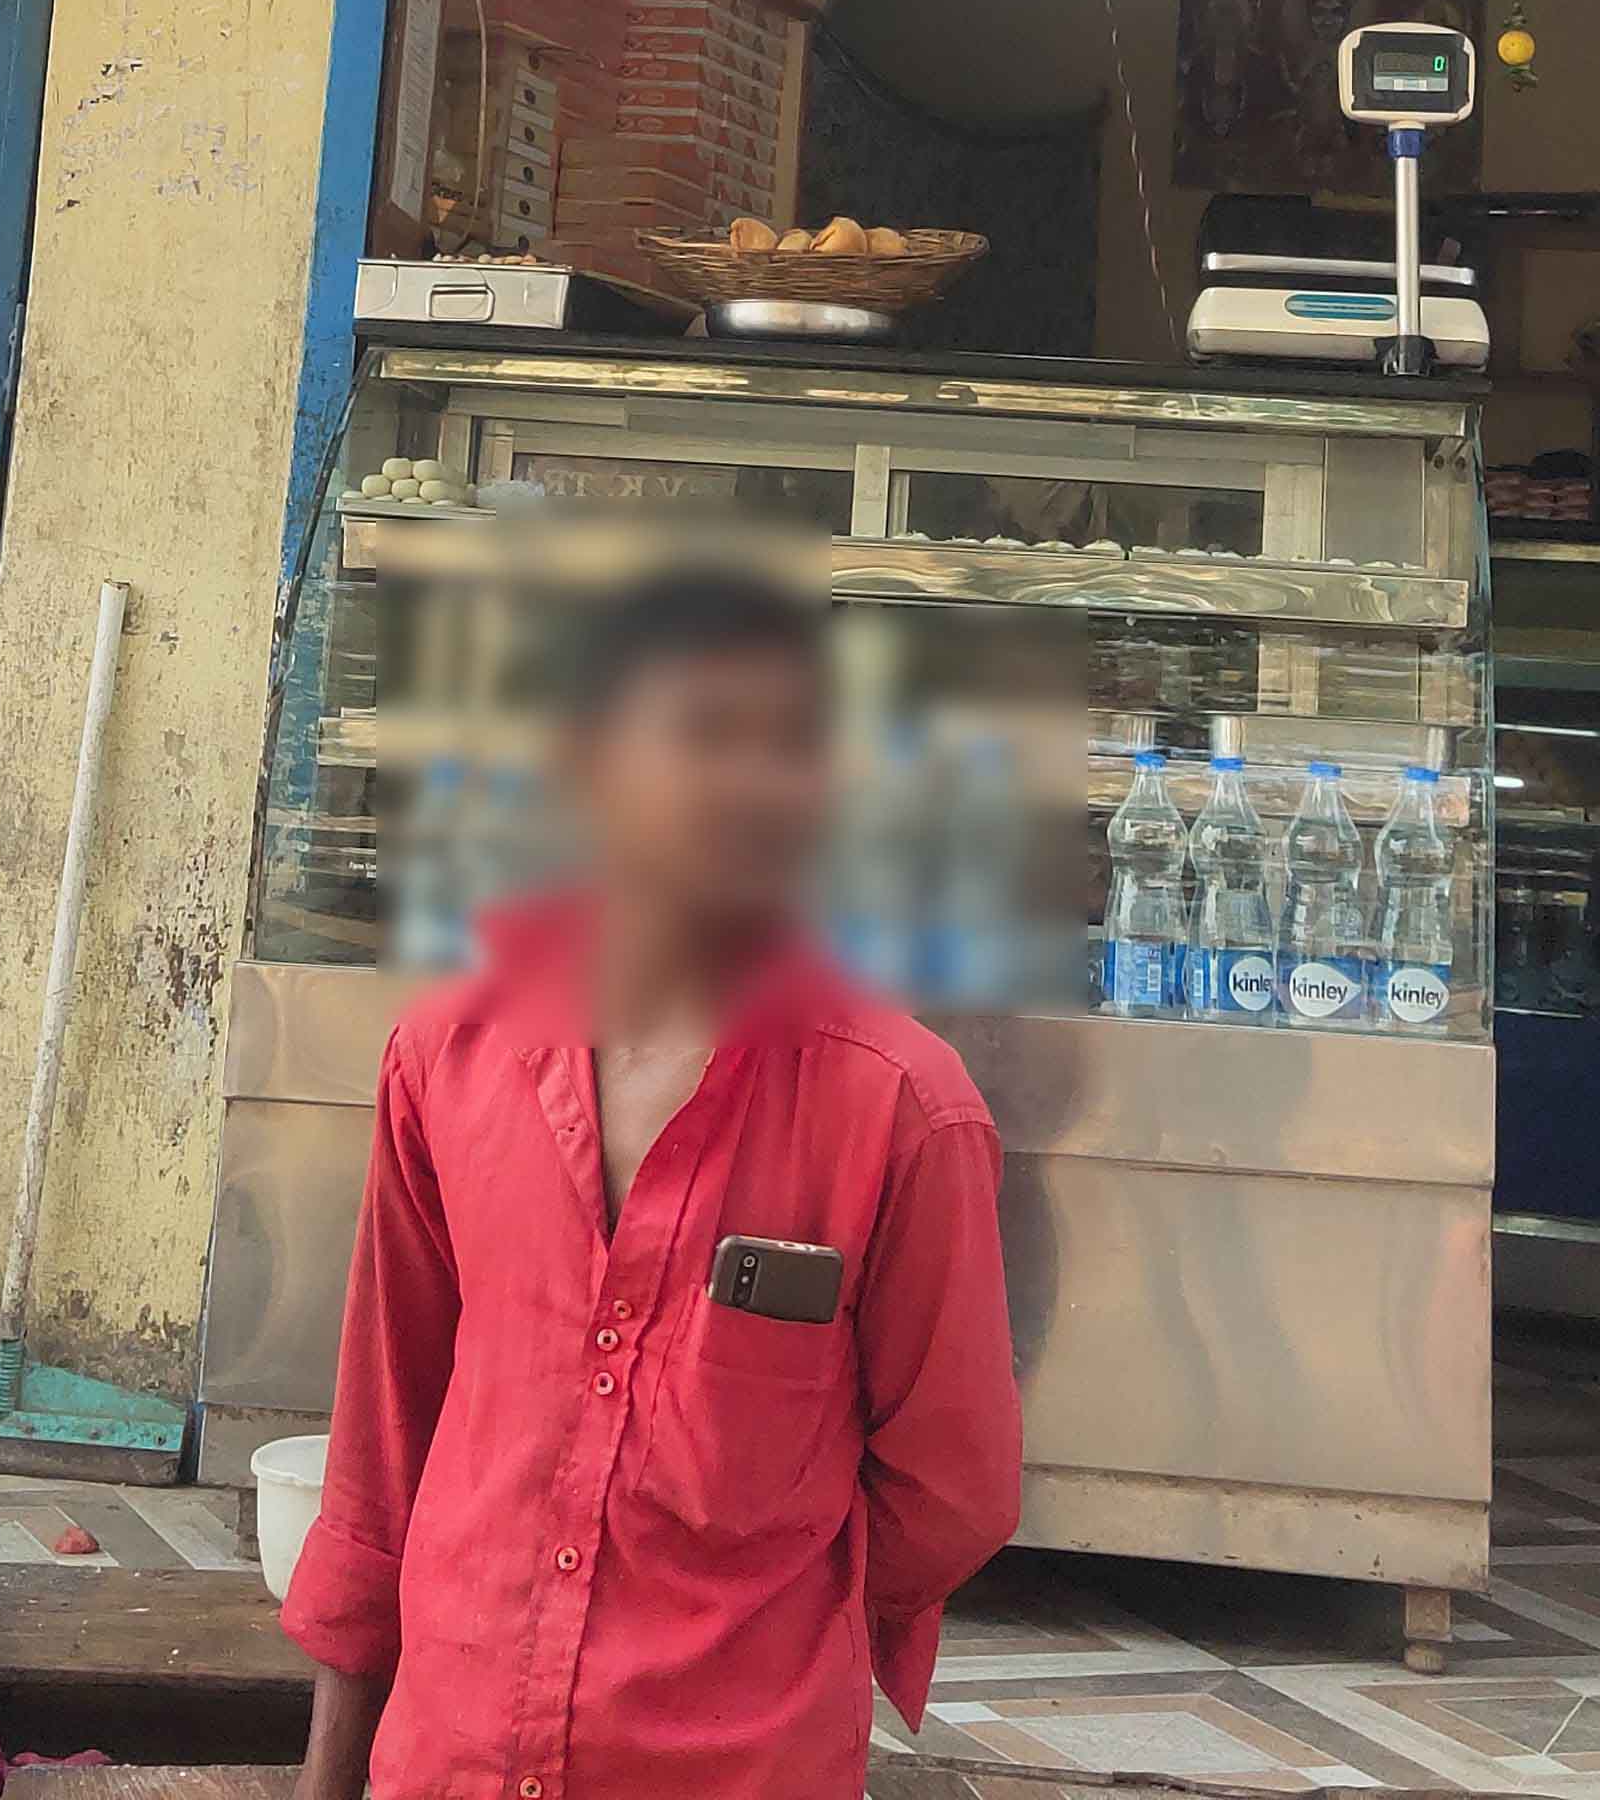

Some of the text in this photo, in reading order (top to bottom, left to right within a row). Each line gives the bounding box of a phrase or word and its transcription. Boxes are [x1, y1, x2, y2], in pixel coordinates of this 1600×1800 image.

[1433, 55, 1447, 72] 0
[1232, 972, 1273, 993] kinle
[1292, 976, 1349, 1004] kinley
[1390, 982, 1445, 1010] kinley
